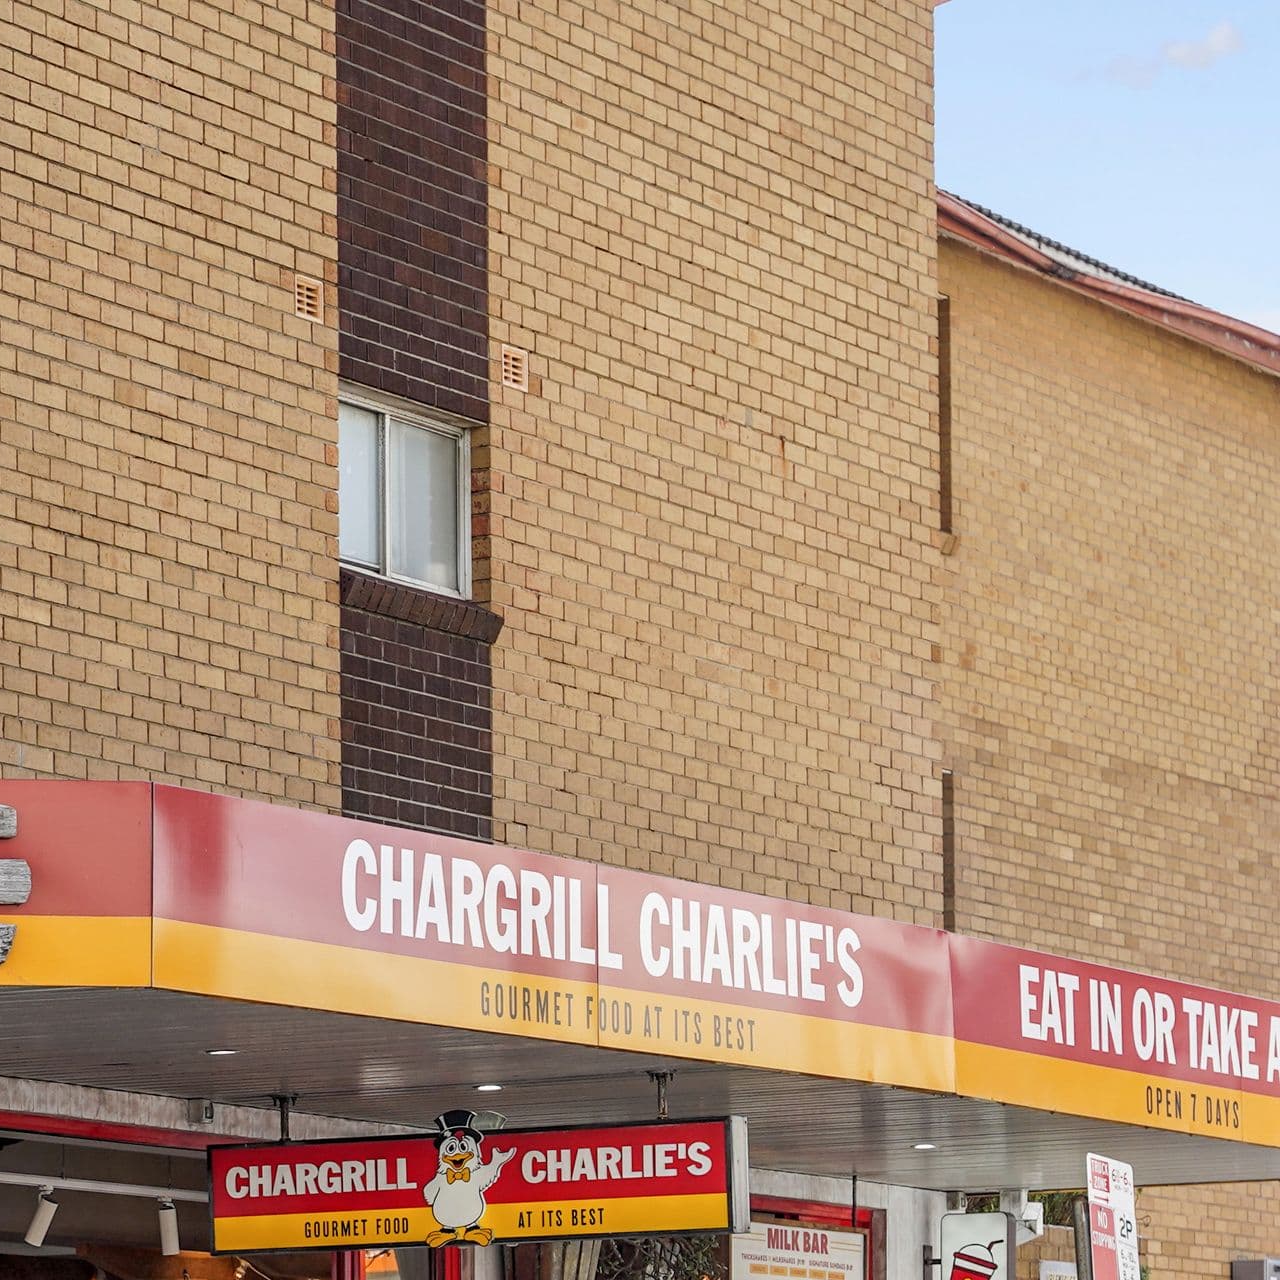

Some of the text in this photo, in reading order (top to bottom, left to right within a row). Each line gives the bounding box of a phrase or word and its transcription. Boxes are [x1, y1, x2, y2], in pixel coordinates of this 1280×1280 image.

[341, 838, 864, 1008] CHARGRILL CHARLIE'S
[480, 981, 756, 1052] GOURMET FOOD AT ITS BEST
[1019, 964, 1080, 1047] EAT
[1089, 978, 1123, 1055] IN
[1132, 987, 1176, 1065] OR
[1182, 997, 1260, 1080] TAKE
[1146, 1085, 1240, 1129] OPEN 7 DAYS
[225, 1142, 713, 1199] CHARGRILL CHARLIE'S
[304, 1207, 604, 1239] GOURMET FOOD AT ITS BEST
[1097, 1212, 1108, 1228] NO
[1119, 1217, 1133, 1239] 2P
[768, 1228, 829, 1255] MILK BAR
[1092, 1230, 1116, 1249] STOPPING
